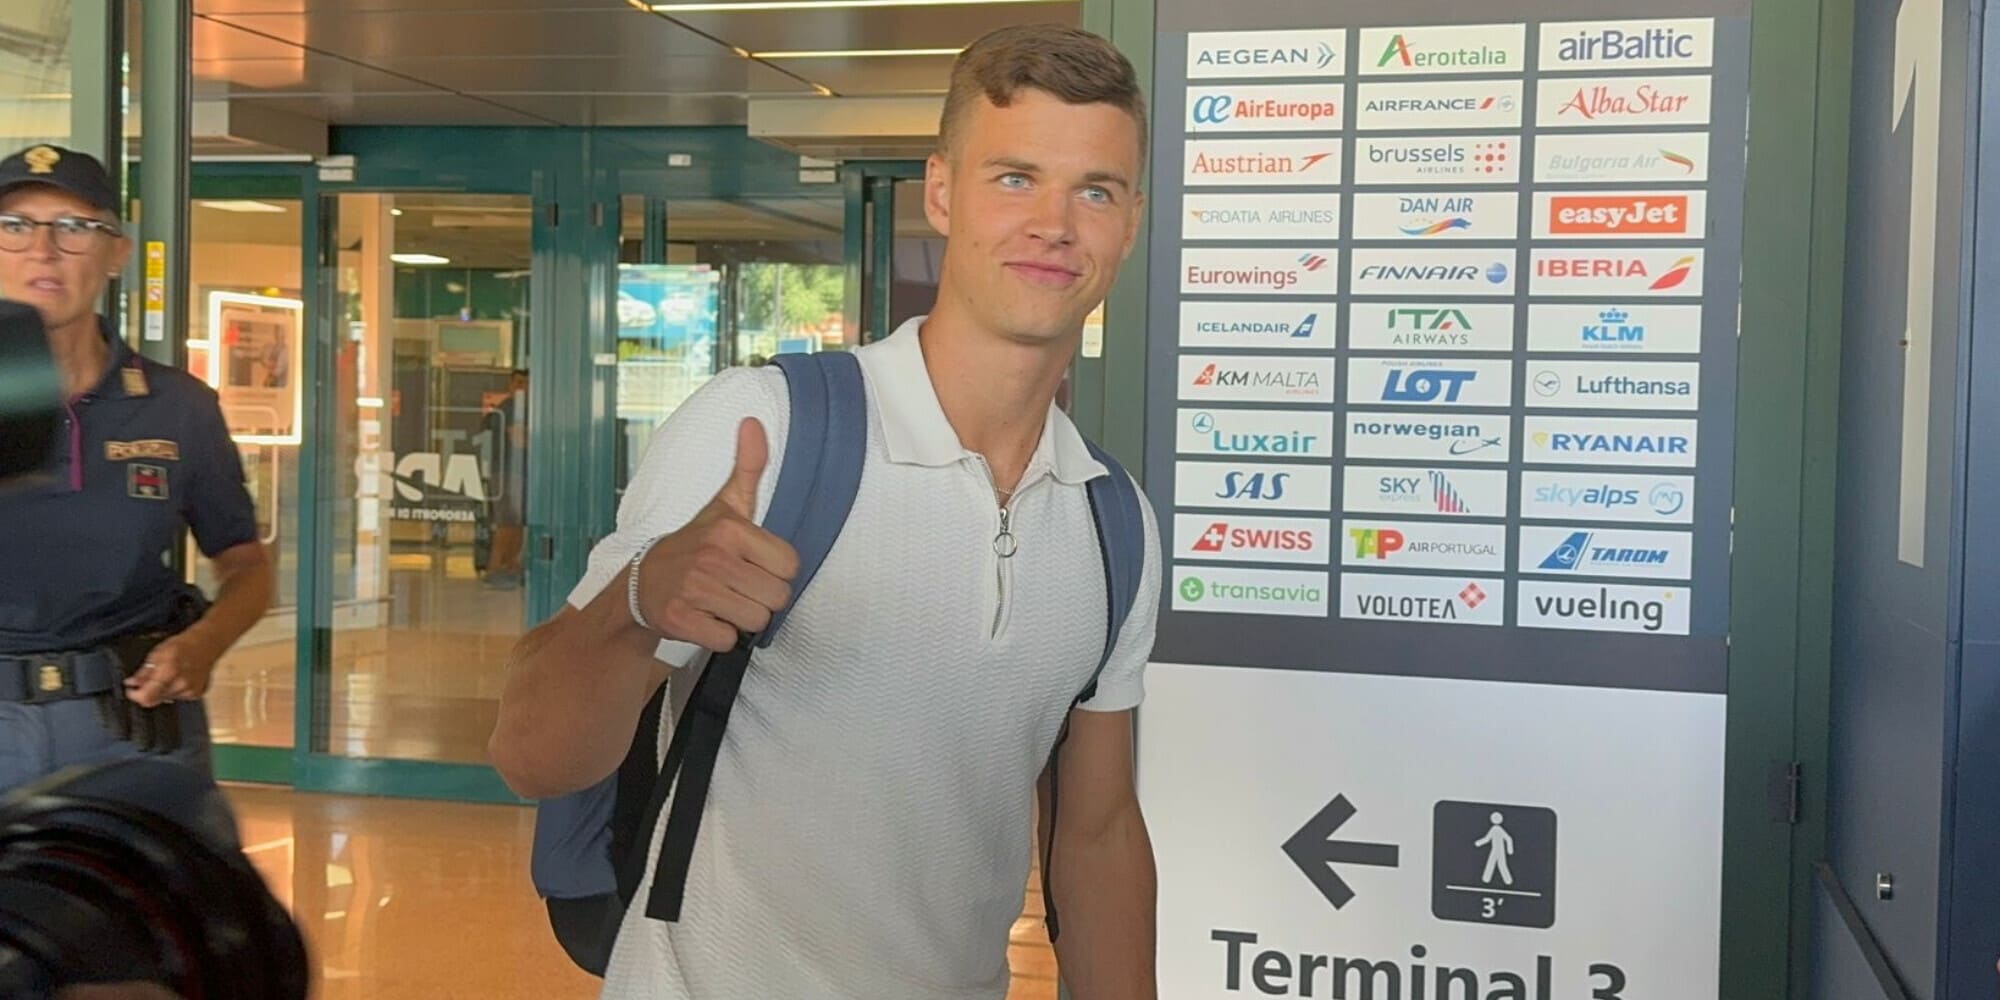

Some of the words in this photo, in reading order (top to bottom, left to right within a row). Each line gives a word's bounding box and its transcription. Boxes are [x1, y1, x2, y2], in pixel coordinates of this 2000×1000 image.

[1376, 34, 1507, 67] Aeroitalia
[1558, 28, 1693, 61] airBaltic
[1197, 48, 1308, 65] AEGEAN
[1234, 100, 1334, 120] AirEuropa
[1365, 98, 1476, 111] AIRFRANCE
[1191, 152, 1292, 173] Austrian
[1369, 144, 1465, 163] brussels
[1550, 154, 1629, 173] Bulgaria
[1633, 154, 1659, 169] Air
[1416, 166, 1465, 174] AIRLINES
[1399, 198, 1439, 213] DAN
[1443, 198, 1473, 213] AIR
[1558, 202, 1678, 228] easyJet
[1199, 210, 1261, 223] CROATIA
[1268, 210, 1333, 223] AIRLINES
[1188, 266, 1298, 290] Eurowings
[1359, 266, 1479, 280] FINNAIR
[1537, 259, 1648, 277] IBERIA
[1197, 322, 1290, 333] ICELANDAIR
[1387, 309, 1472, 330] ITA
[1393, 334, 1468, 345] AIRWAYS
[1582, 325, 1644, 341] KLM
[1216, 370, 1249, 386] KM
[1252, 371, 1319, 388] MALTA
[1381, 369, 1477, 402] LOT
[1576, 375, 1690, 395] Lufthansa
[1353, 422, 1480, 440] norwegian
[1213, 430, 1317, 453] Luxair
[1551, 433, 1688, 454] RYANAIR
[1215, 471, 1290, 500] SAS
[1379, 477, 1421, 494] SKY
[1534, 483, 1640, 508] skyalps
[1231, 528, 1312, 551] SWISS
[1349, 528, 1404, 560] TAP
[1591, 547, 1669, 564] TAROM
[1211, 581, 1320, 602] transavia
[1357, 594, 1456, 619] VOLOTEA
[1535, 587, 1663, 631] vueling
[1211, 929, 1552, 1000] Terminal
